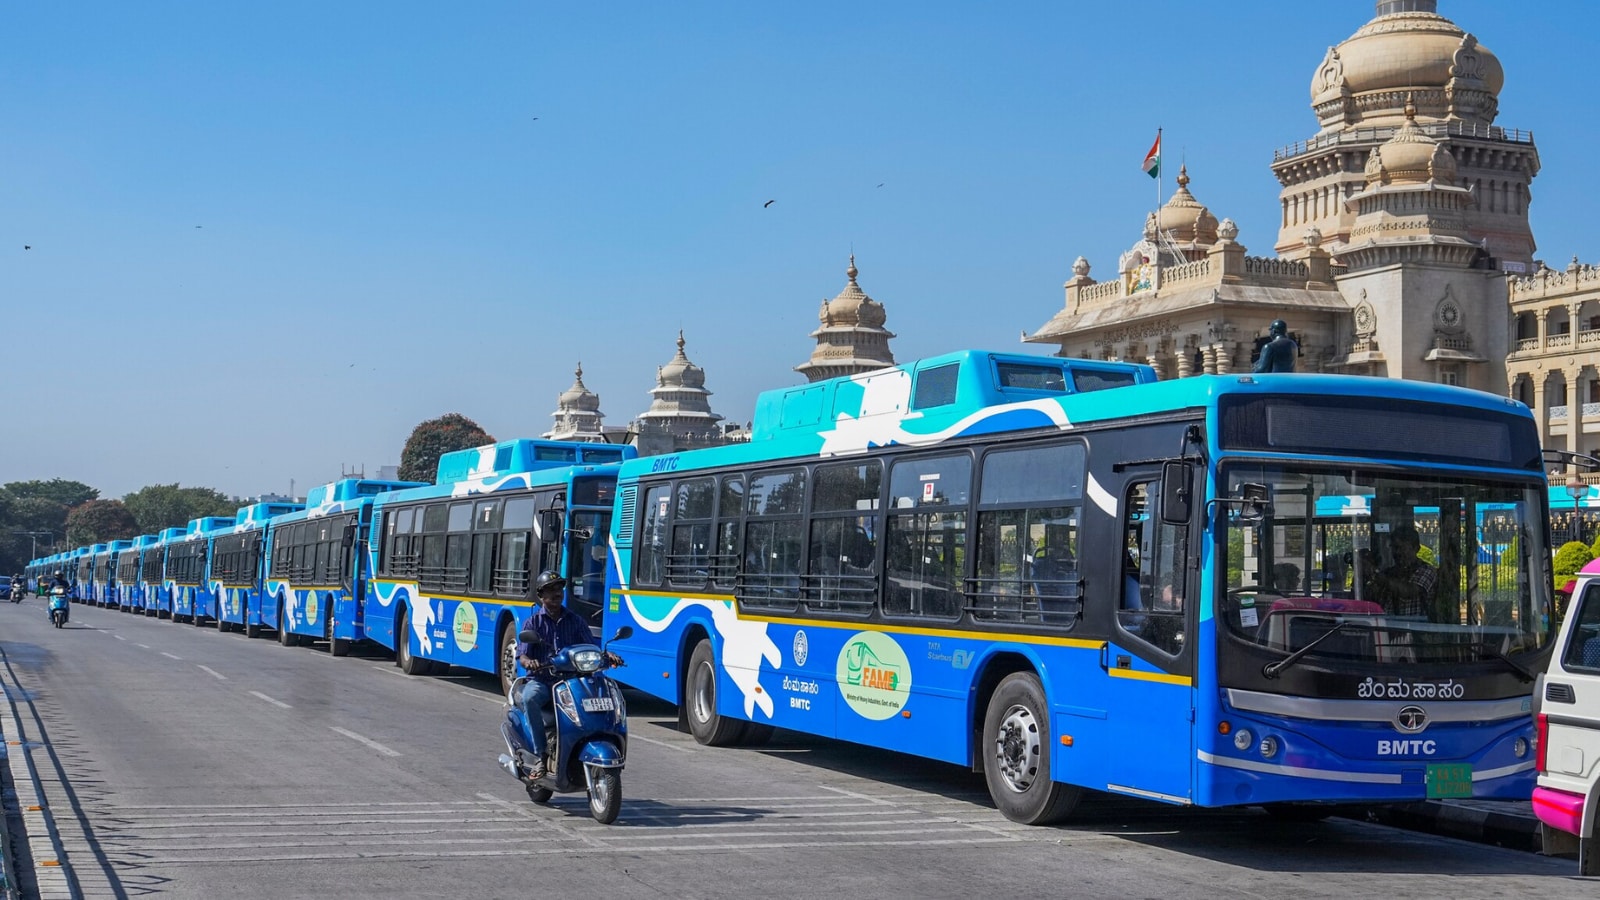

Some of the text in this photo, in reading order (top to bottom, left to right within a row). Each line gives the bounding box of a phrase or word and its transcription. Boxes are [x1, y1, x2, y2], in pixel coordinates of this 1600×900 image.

[652, 456, 680, 472] BMTC
[928, 641, 941, 650] TATA
[928, 649, 976, 669] Starbus EV
[863, 667, 896, 691] FAME
[790, 697, 810, 710] BMTC
[1377, 741, 1436, 755] BMTC
